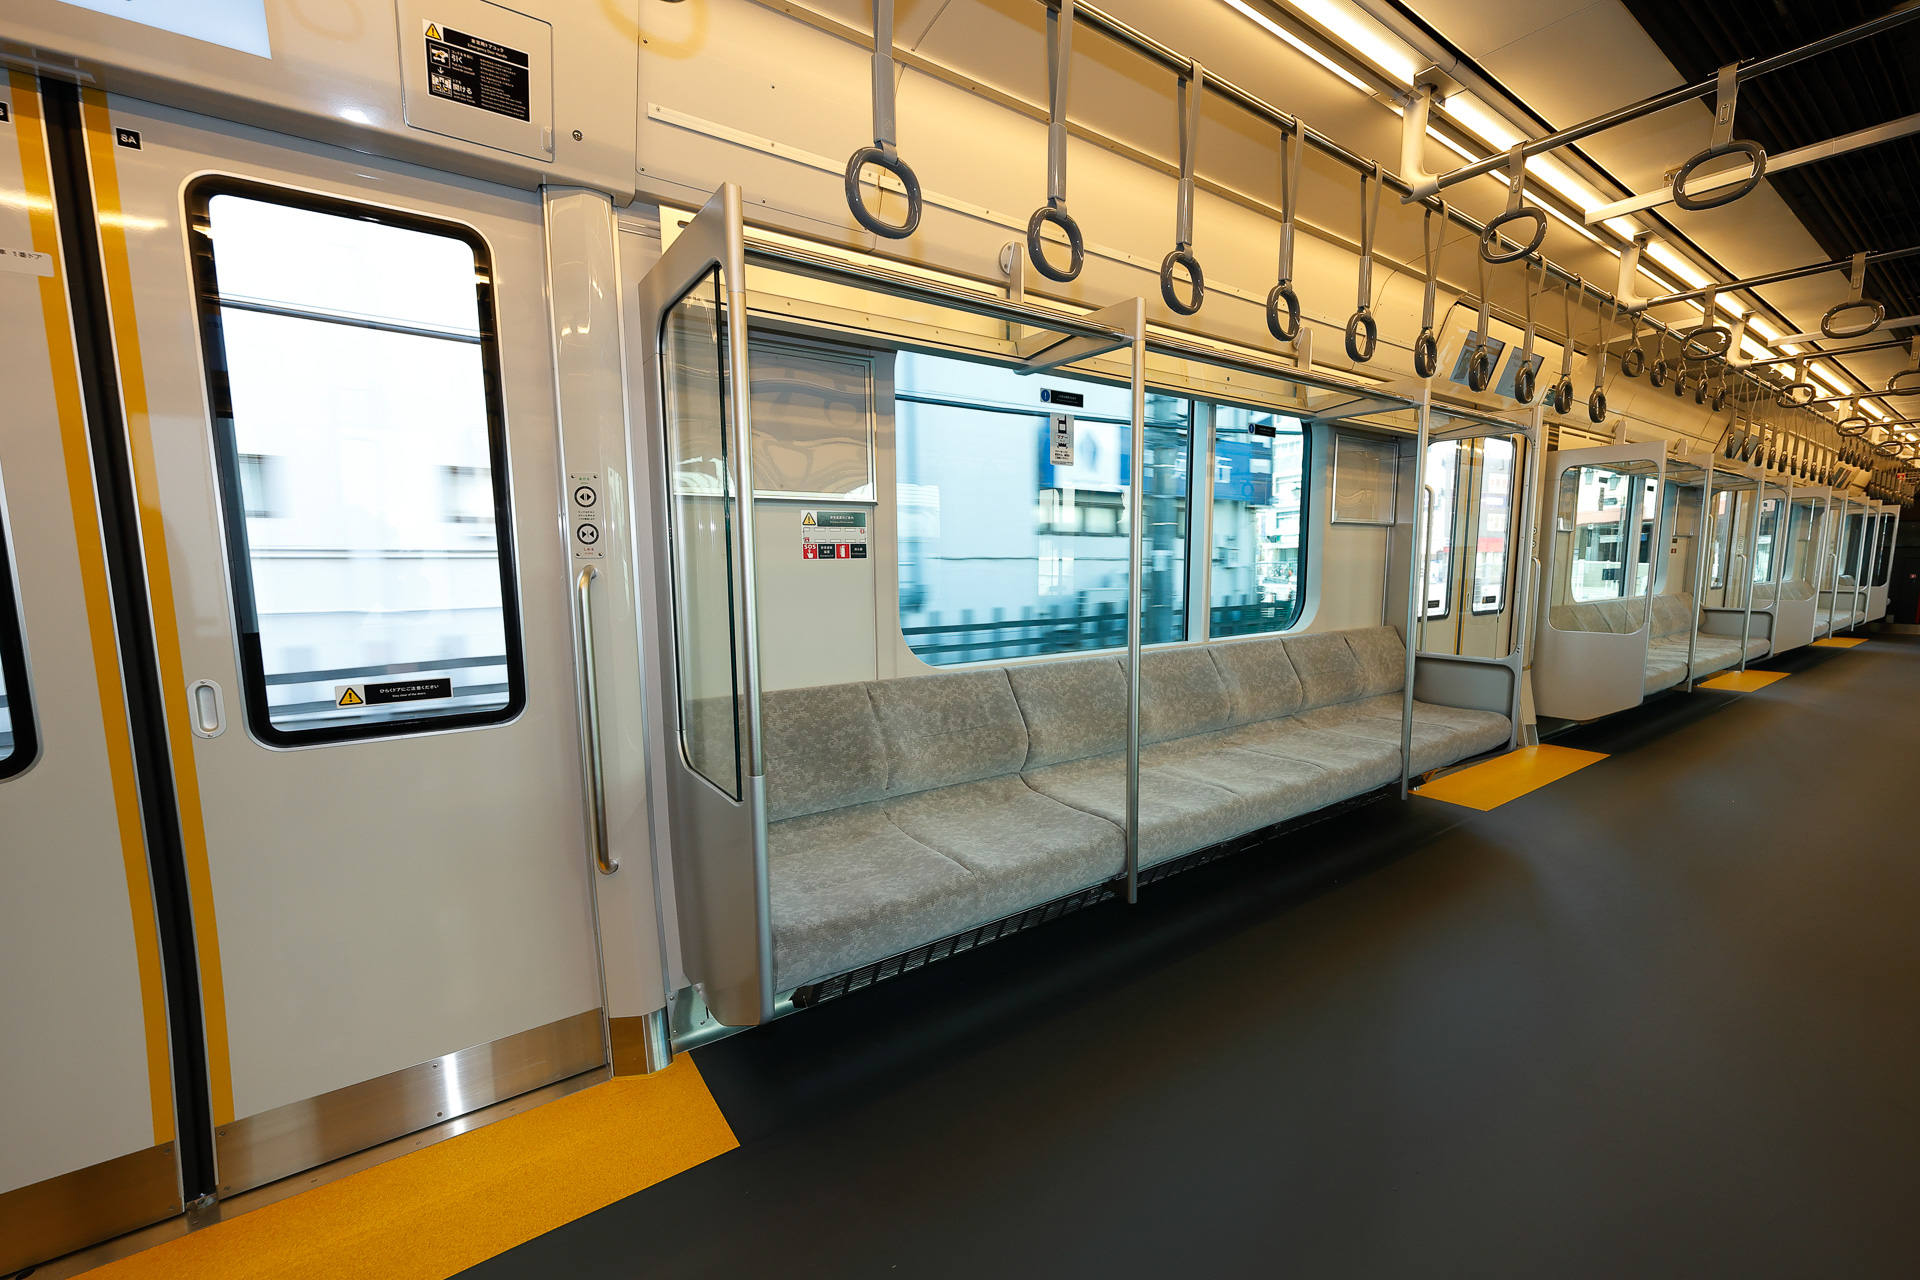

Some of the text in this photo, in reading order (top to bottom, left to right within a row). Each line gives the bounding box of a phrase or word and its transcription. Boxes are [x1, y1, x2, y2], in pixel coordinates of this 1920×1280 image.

[451, 54, 463, 64] 引く
[452, 83, 473, 95] 開ける
[379, 684, 439, 694] ひらくドアにご注意ください
